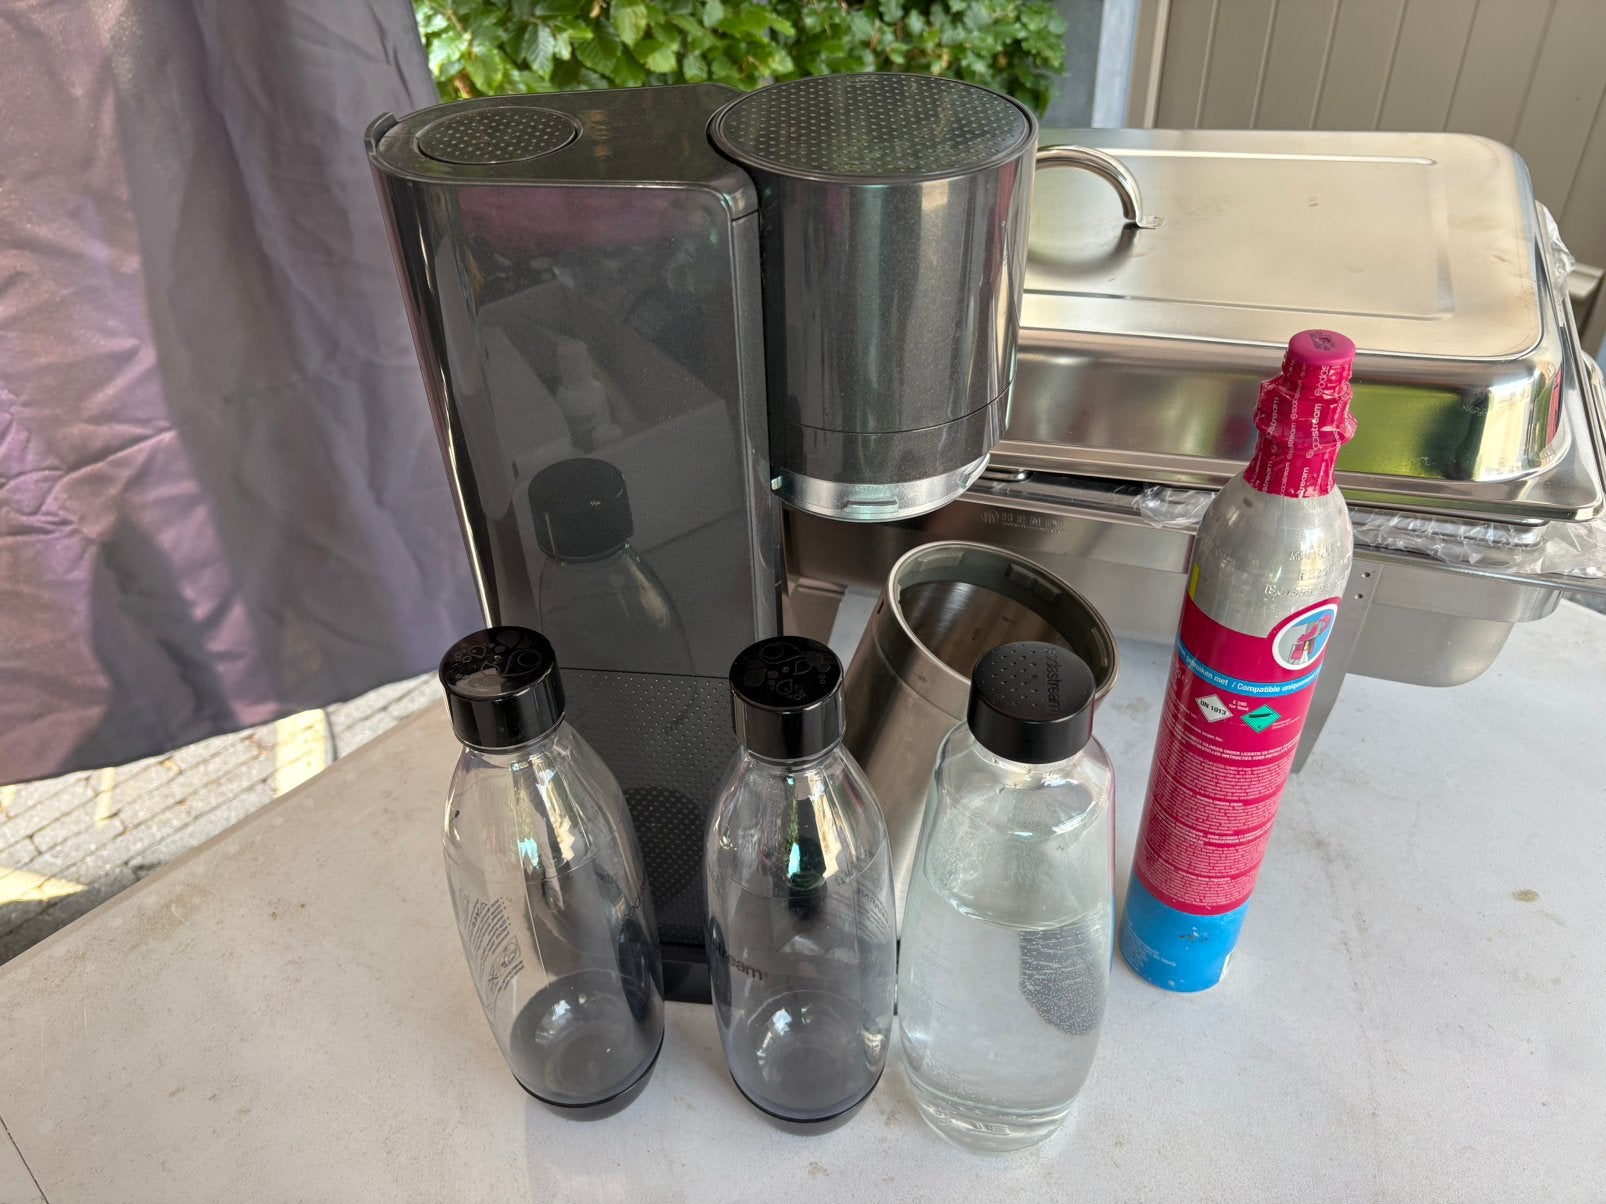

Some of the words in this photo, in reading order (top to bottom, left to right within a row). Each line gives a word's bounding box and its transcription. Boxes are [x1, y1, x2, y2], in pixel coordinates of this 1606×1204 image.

[1214, 675, 1229, 686] met
[1237, 682, 1281, 693] Compatible
[1200, 700, 1210, 709] UN
[1210, 705, 1227, 716] 1013
